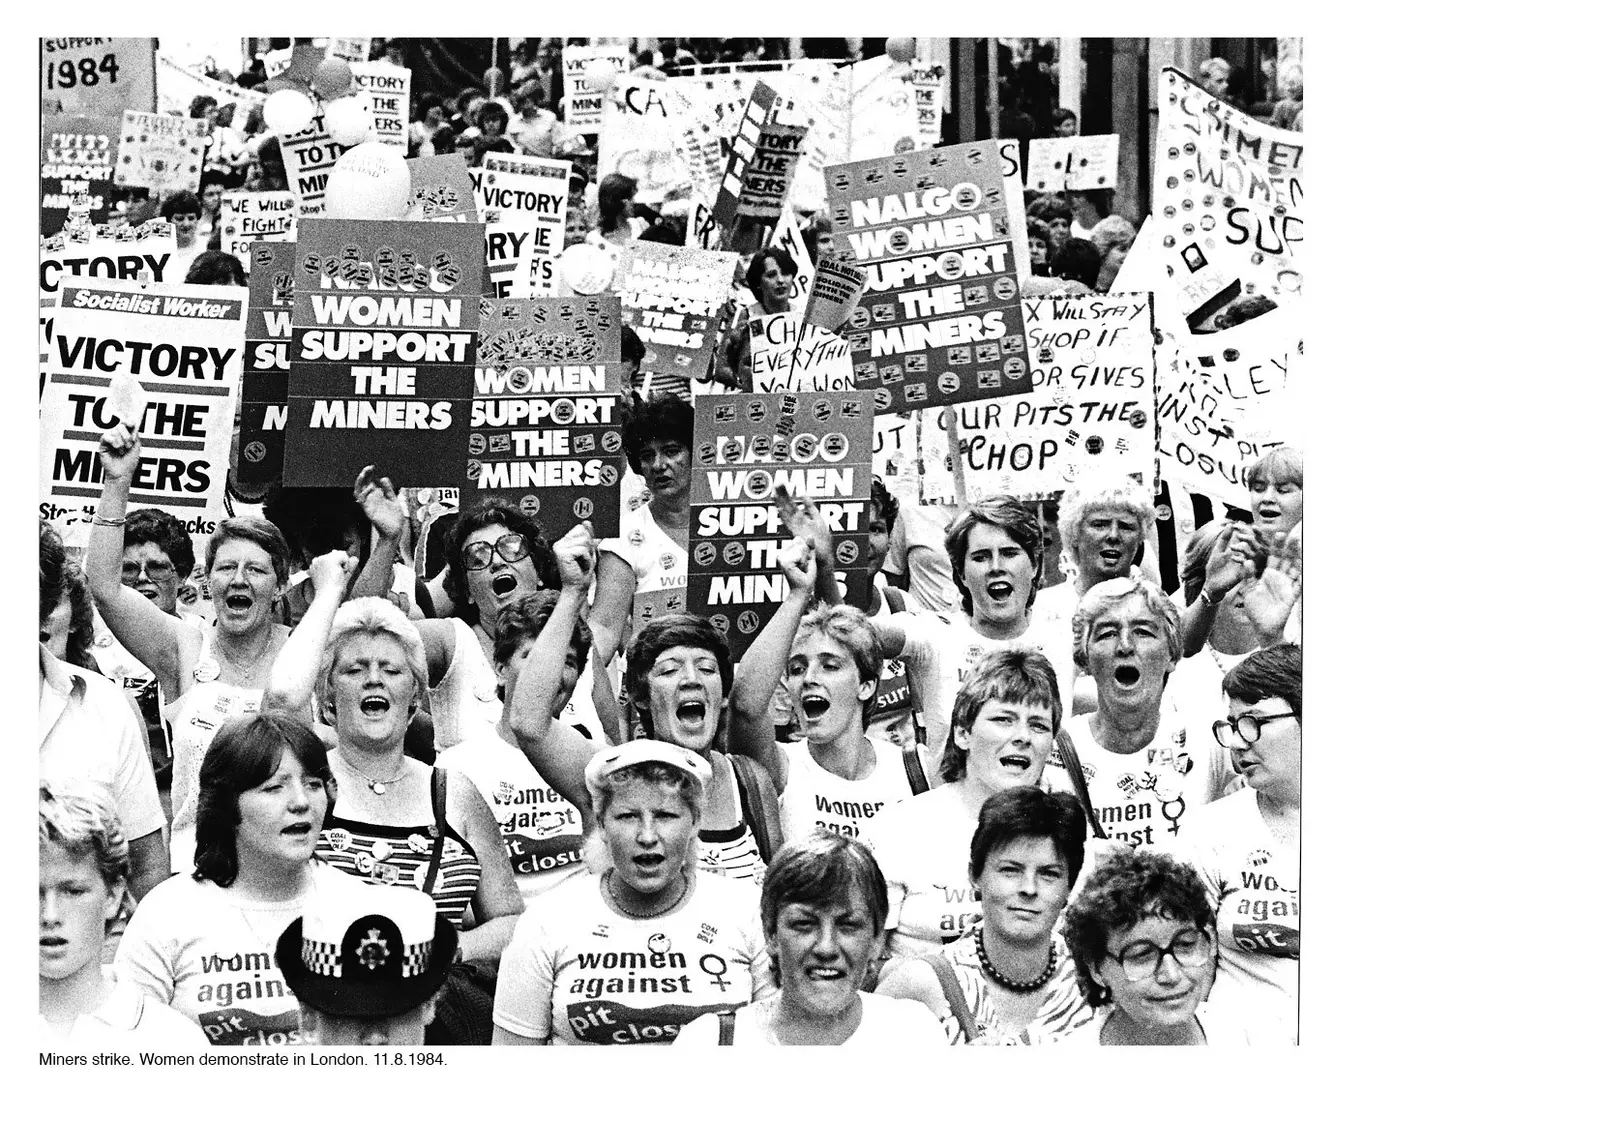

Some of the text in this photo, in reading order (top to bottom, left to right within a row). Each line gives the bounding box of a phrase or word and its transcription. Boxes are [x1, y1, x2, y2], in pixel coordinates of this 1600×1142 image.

[47, 53, 119, 89] 1984
[372, 97, 400, 111] THE
[375, 118, 403, 131] ERS
[294, 146, 323, 165] TO
[231, 199, 287, 213] WE WILL
[484, 186, 564, 214] VICTORY
[851, 182, 983, 228] NALGO
[243, 216, 285, 232] FIGHT
[848, 213, 994, 262] WOMEN
[820, 260, 840, 272] COAL
[73, 289, 231, 319] Socialist Worker
[310, 296, 462, 328] WOMEN
[898, 284, 966, 320] THE
[1053, 301, 1087, 320] WILL
[1088, 302, 1147, 321] STAY
[300, 330, 472, 362] SUPPORT
[870, 310, 1007, 358] MINERS
[1029, 327, 1091, 350] SHOP
[56, 335, 236, 380] VICTORY
[350, 366, 417, 396] THE
[475, 366, 606, 394] WOMEN
[1071, 365, 1146, 390] GIVES
[309, 400, 453, 431] MINERS
[471, 398, 616, 427] SUPPORT
[1014, 401, 1075, 427] PITS
[1079, 401, 1139, 424] THE
[511, 430, 570, 457] THE
[967, 435, 1058, 471] CHOP
[52, 448, 211, 494] MIERS
[478, 460, 603, 490] MINERS
[706, 467, 854, 500] WOMEN
[877, 686, 910, 709] sur
[1117, 775, 1134, 789] COAL
[701, 922, 719, 935] COAL
[577, 951, 687, 970] women
[197, 973, 295, 1007] again
[569, 971, 693, 999] against
[203, 1015, 248, 1041] pit
[568, 1006, 616, 1037] pit
